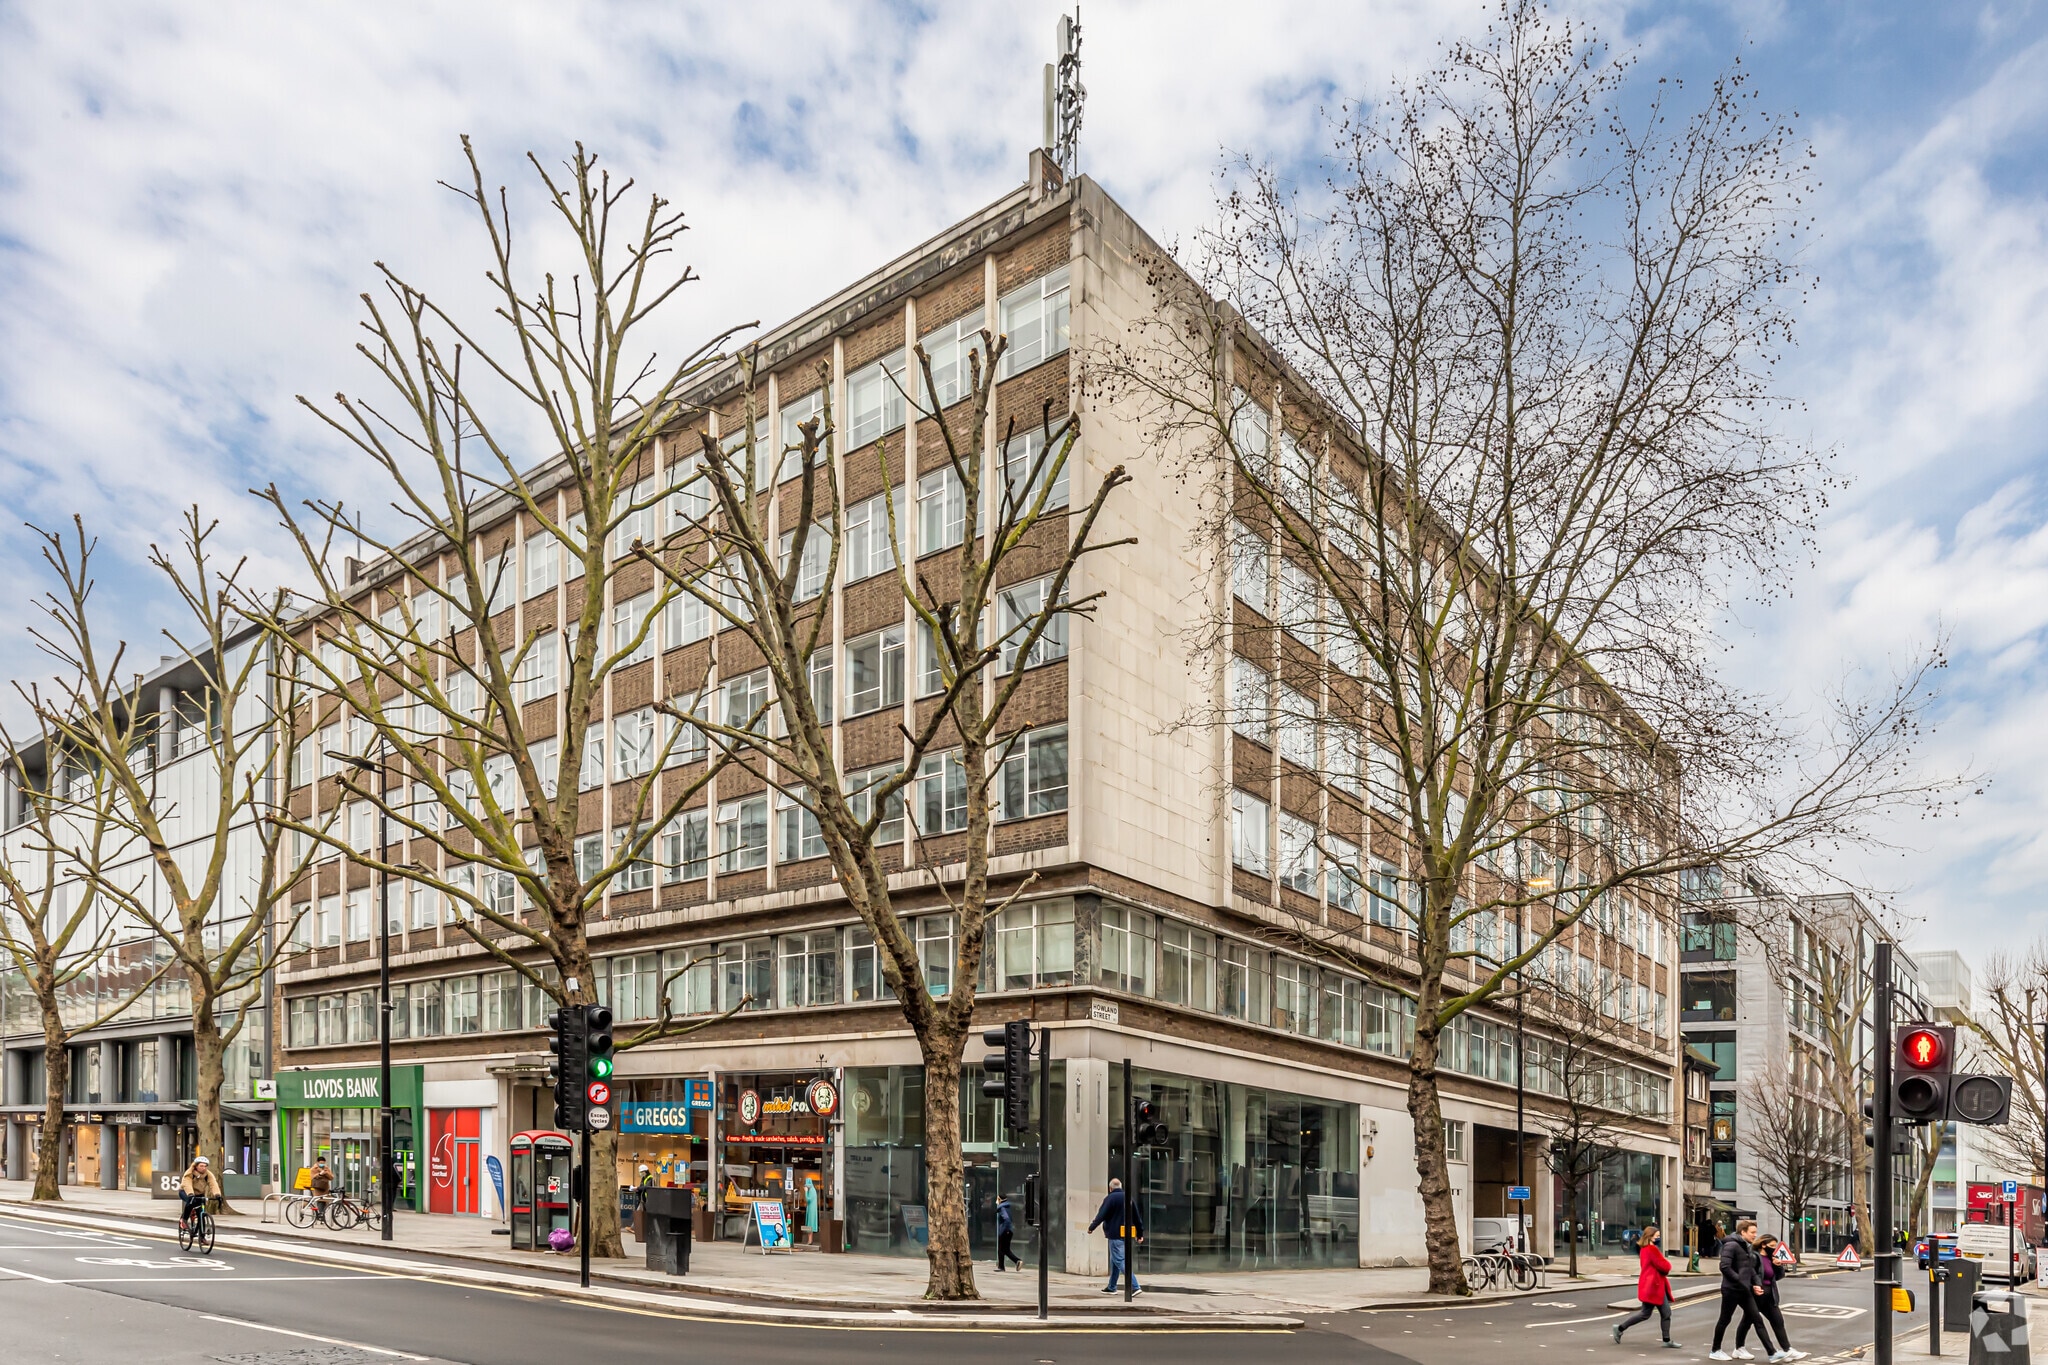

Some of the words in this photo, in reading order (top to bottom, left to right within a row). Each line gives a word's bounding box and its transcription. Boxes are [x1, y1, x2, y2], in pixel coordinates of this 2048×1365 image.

[1093, 1004, 1118, 1015] HOWLAND
[1093, 1011, 1111, 1020] STREET
[303, 1077, 344, 1099] LLOYDS
[346, 1076, 379, 1098] BANK
[762, 1096, 793, 1114] mikel
[635, 1107, 687, 1126] GREGGS
[160, 1175, 181, 1191] 85
[2006, 1182, 2015, 1192] P
